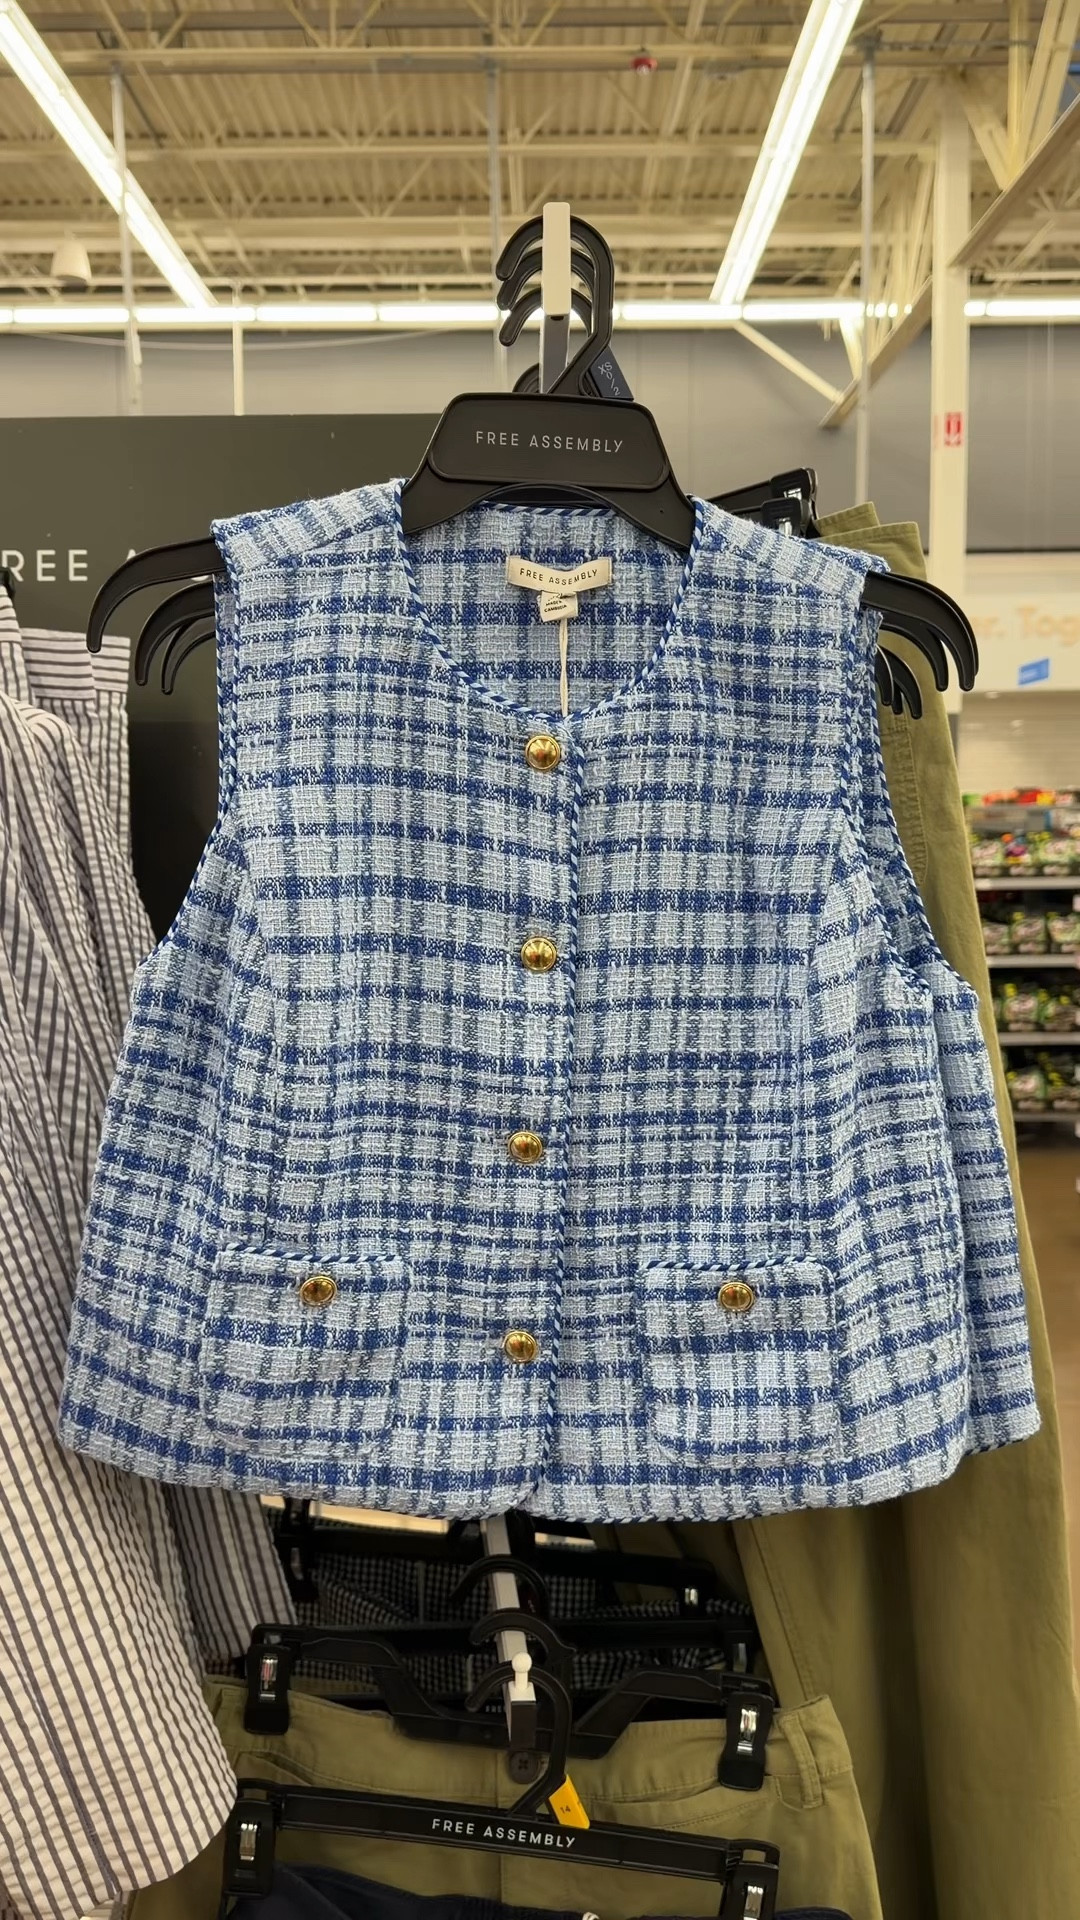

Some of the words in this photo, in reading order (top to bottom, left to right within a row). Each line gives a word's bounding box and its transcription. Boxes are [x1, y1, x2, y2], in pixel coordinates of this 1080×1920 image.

[597, 361, 613, 375] XS
[606, 371, 621, 396] 0/2
[475, 430, 519, 446] FREE
[529, 434, 623, 453] ASSEMBLY
[1, 549, 88, 582] REE
[519, 567, 544, 582] FREE
[548, 569, 598, 586] ASSEMBLY
[560, 1804, 571, 1815] 14
[431, 1818, 475, 1835] FREE
[483, 1825, 576, 1848] ASSEMBLY
